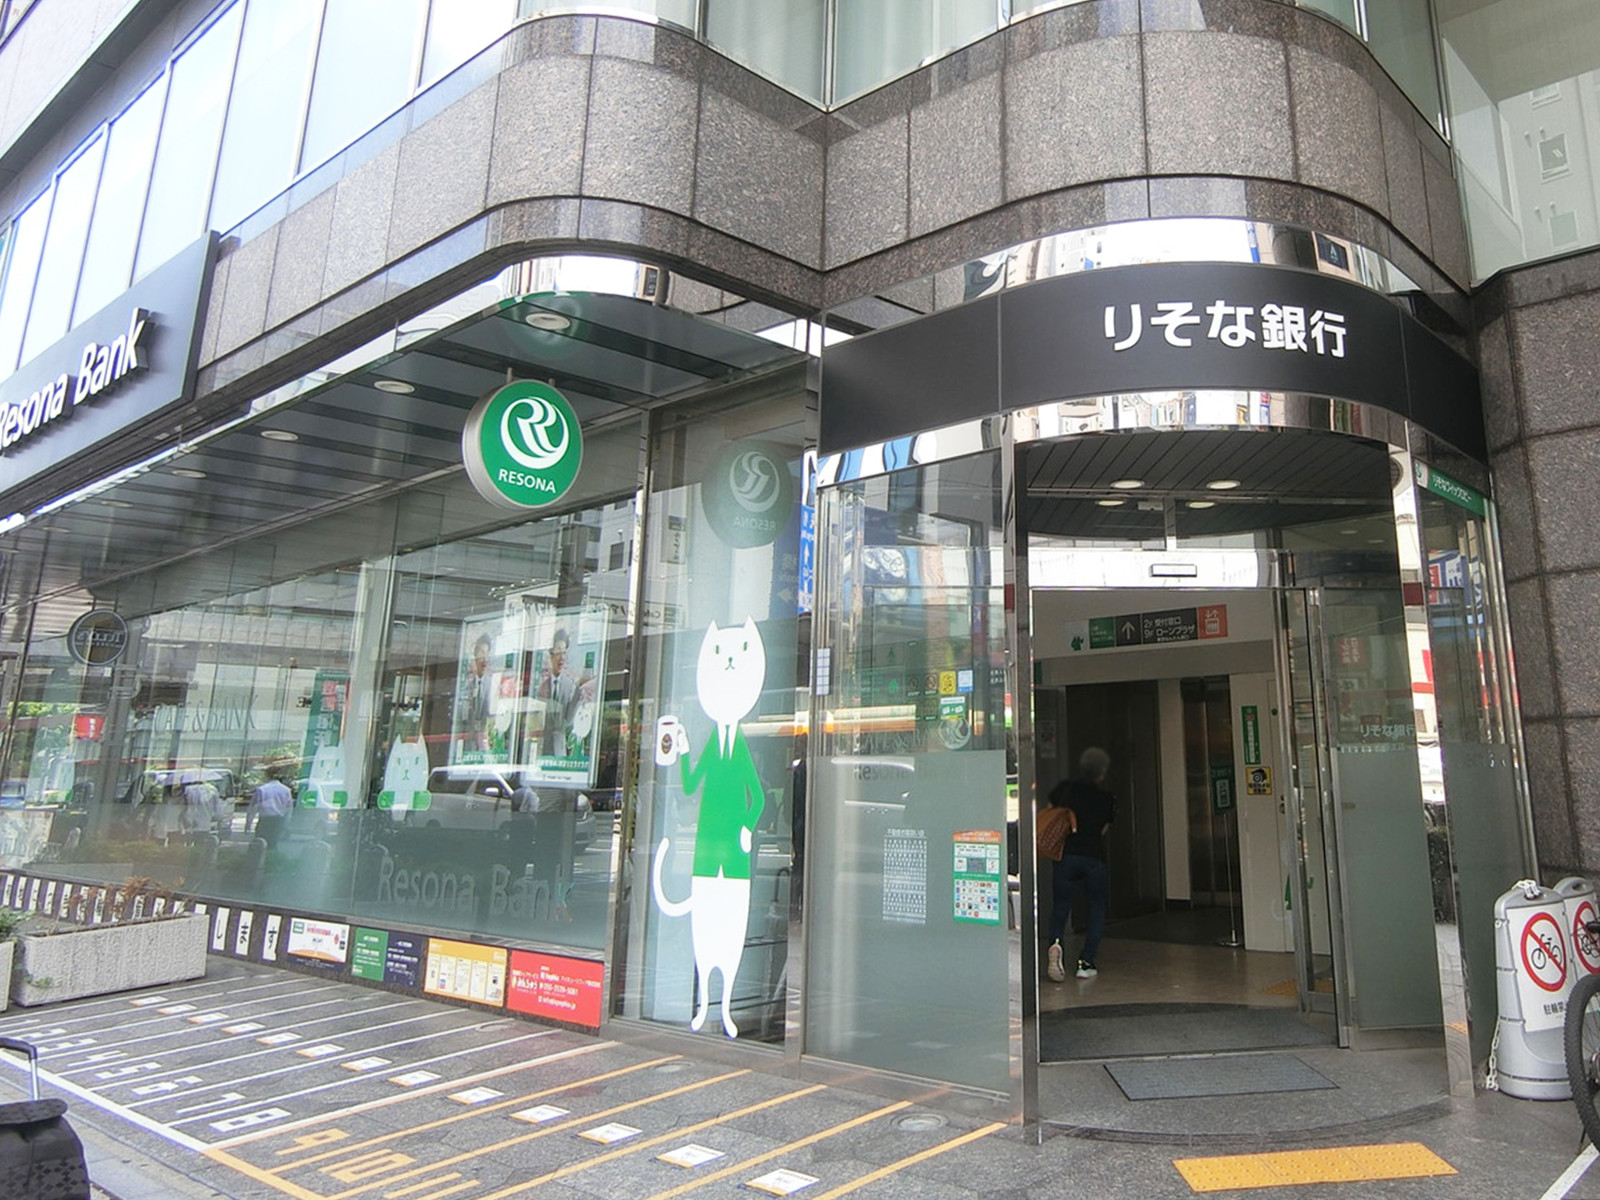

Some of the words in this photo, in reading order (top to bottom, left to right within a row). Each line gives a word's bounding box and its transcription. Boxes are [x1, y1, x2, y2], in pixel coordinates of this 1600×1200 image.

[1104, 300, 1347, 358] りそな銀行
[73, 306, 147, 405] Bank
[498, 467, 556, 494] RESONA
[1156, 624, 1196, 637] ローンプラザ
[207, 694, 259, 732] BANK
[378, 855, 480, 915] Resona
[489, 863, 575, 923] Bank
[1543, 1001, 1565, 1016] 駐輪禁
[94, 1061, 163, 1080] 5
[131, 1074, 204, 1096] 6
[208, 1107, 292, 1133] 8
[275, 1127, 351, 1156] 9
[317, 1148, 418, 1184] 10
